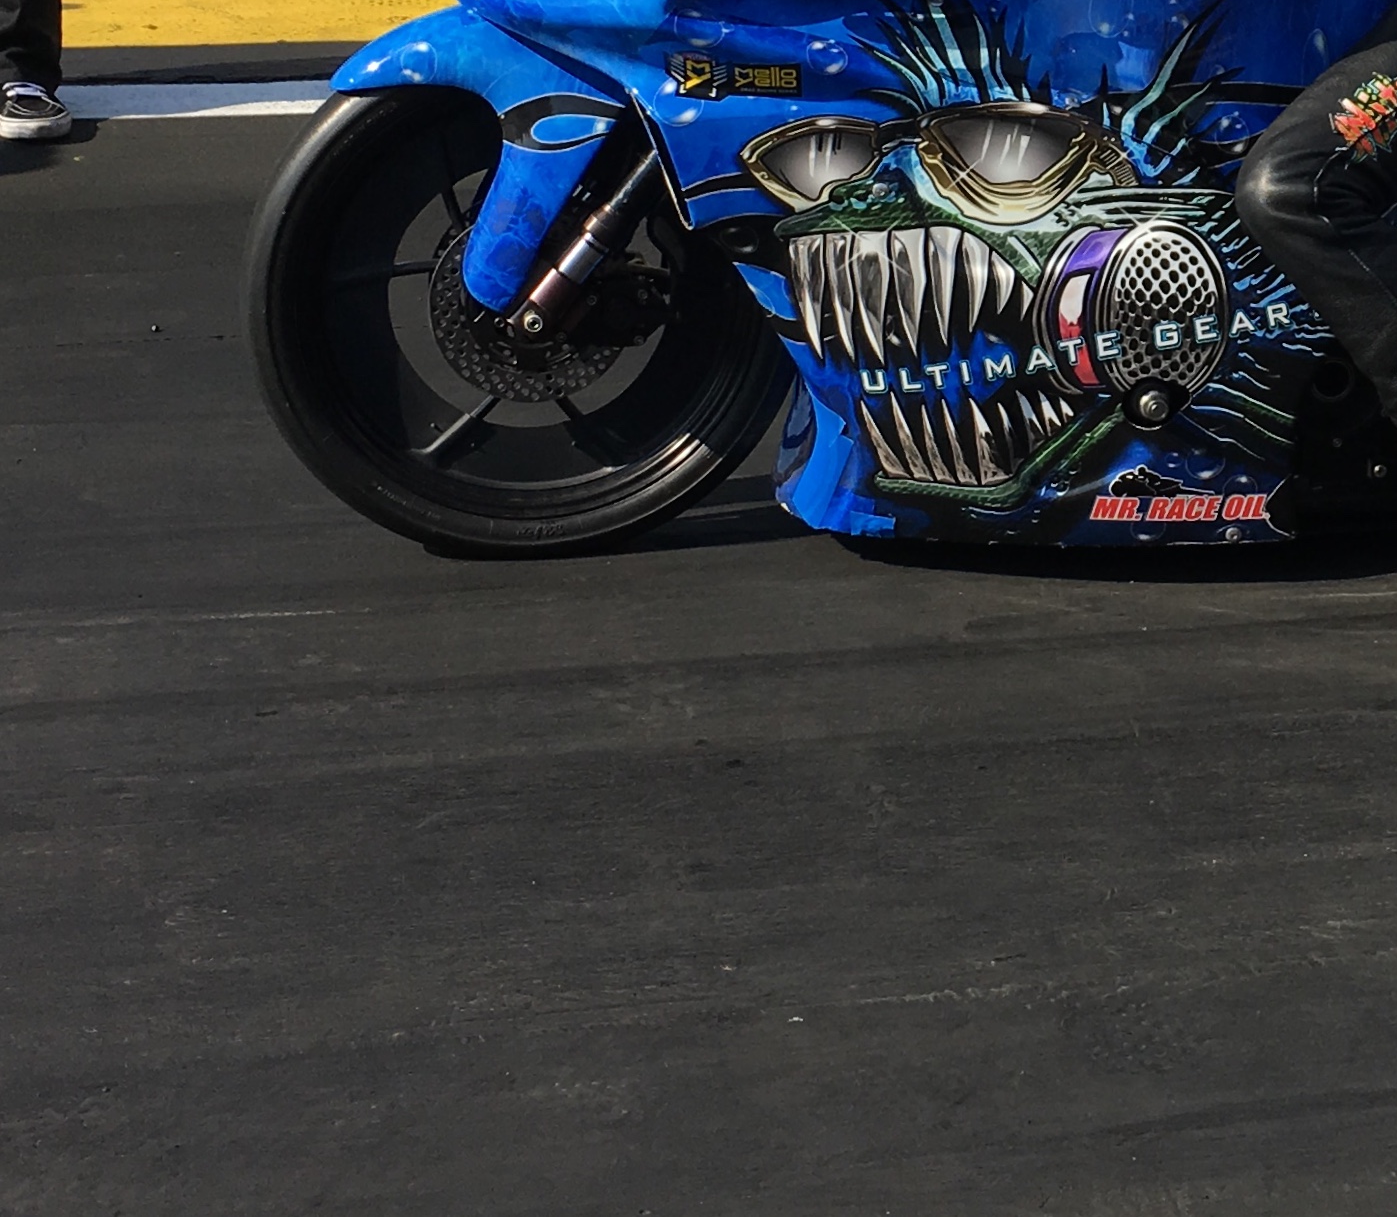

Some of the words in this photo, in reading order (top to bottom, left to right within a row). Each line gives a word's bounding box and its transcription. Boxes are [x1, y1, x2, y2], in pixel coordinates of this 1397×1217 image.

[858, 330, 1123, 395] ULTIMATE
[1153, 299, 1292, 352] GEAR
[1089, 495, 1144, 523] MR.
[1145, 494, 1221, 523] RACE
[1223, 493, 1269, 521] OIL
